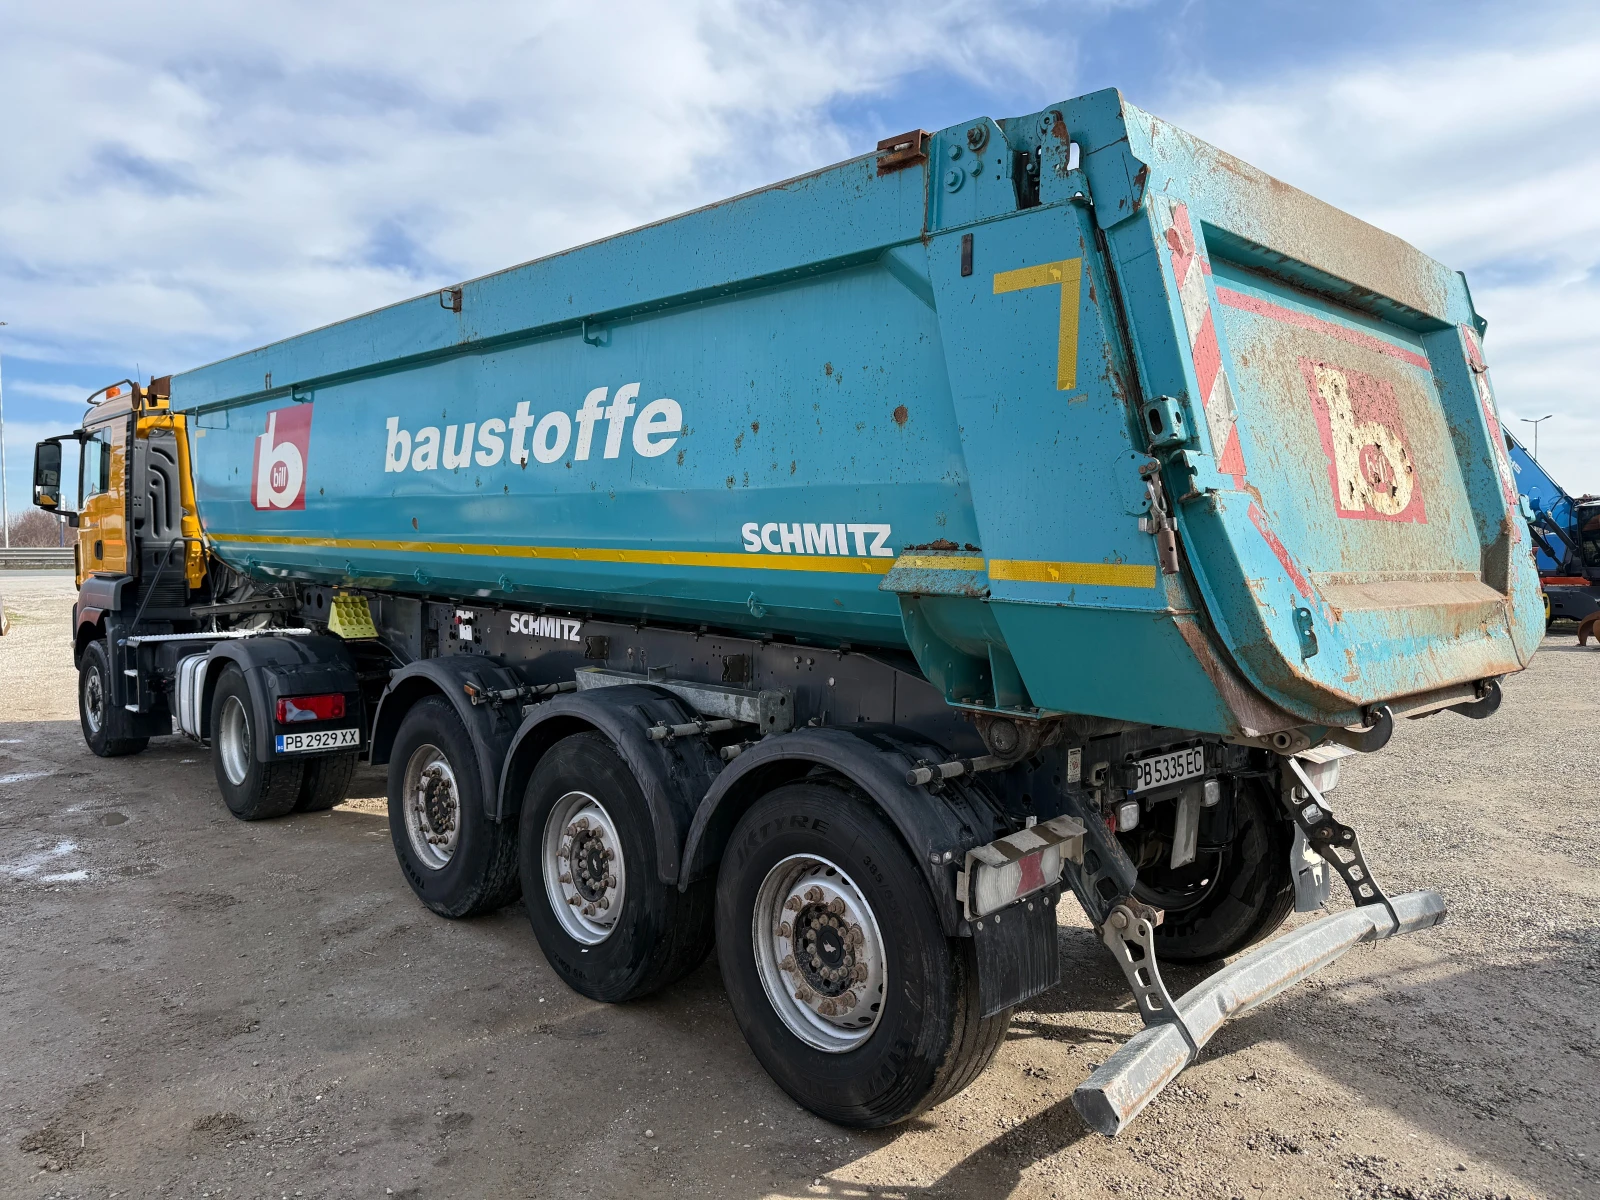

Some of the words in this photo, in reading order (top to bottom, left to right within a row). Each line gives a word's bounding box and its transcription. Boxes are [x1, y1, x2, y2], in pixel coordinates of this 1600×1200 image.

[384, 382, 683, 473] baustoffe
[273, 466, 287, 487] bill
[741, 522, 894, 557] SCHMITZ
[510, 613, 580, 641] SCHMITZ
[285, 735, 303, 750] PB
[306, 732, 338, 748] 2929
[340, 730, 357, 745] XX
[1154, 755, 1184, 783] 5335
[1185, 750, 1202, 775] EC
